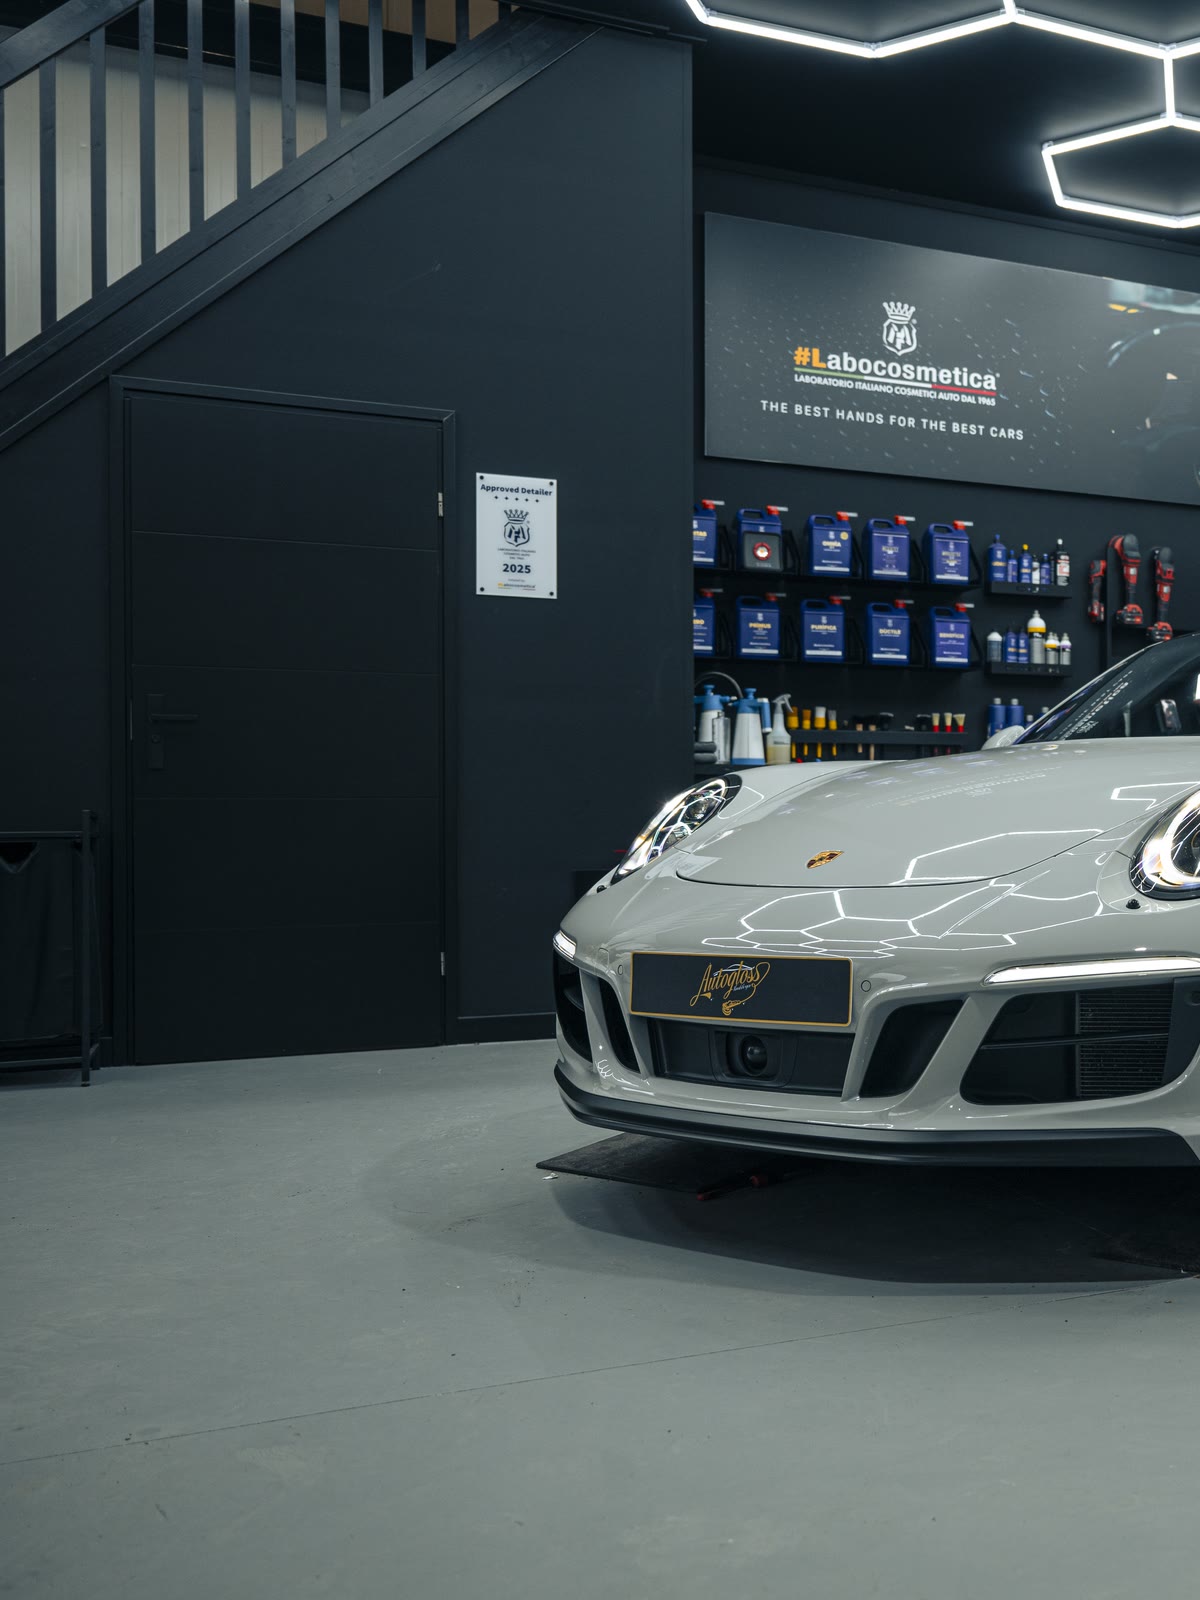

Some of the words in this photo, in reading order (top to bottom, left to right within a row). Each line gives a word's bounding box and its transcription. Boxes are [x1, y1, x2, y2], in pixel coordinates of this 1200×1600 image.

[794, 374, 854, 389] LABORATORIO
[855, 381, 893, 394] ITALIANO
[894, 386, 937, 399] COSMETICI
[938, 392, 960, 402] AUTO
[961, 394, 977, 405] DAL
[978, 396, 996, 407] 1965
[760, 399, 789, 414] THE
[794, 403, 830, 418] BEST
[836, 408, 884, 425] HANDS
[889, 414, 916, 428] FOR
[920, 418, 946, 432] THE
[951, 422, 985, 436] BEST
[989, 426, 1024, 441] CARS
[480, 483, 519, 494] Approved
[521, 487, 553, 497] Detailer
[502, 563, 531, 574] 2025
[690, 961, 771, 1007] Autogloss
